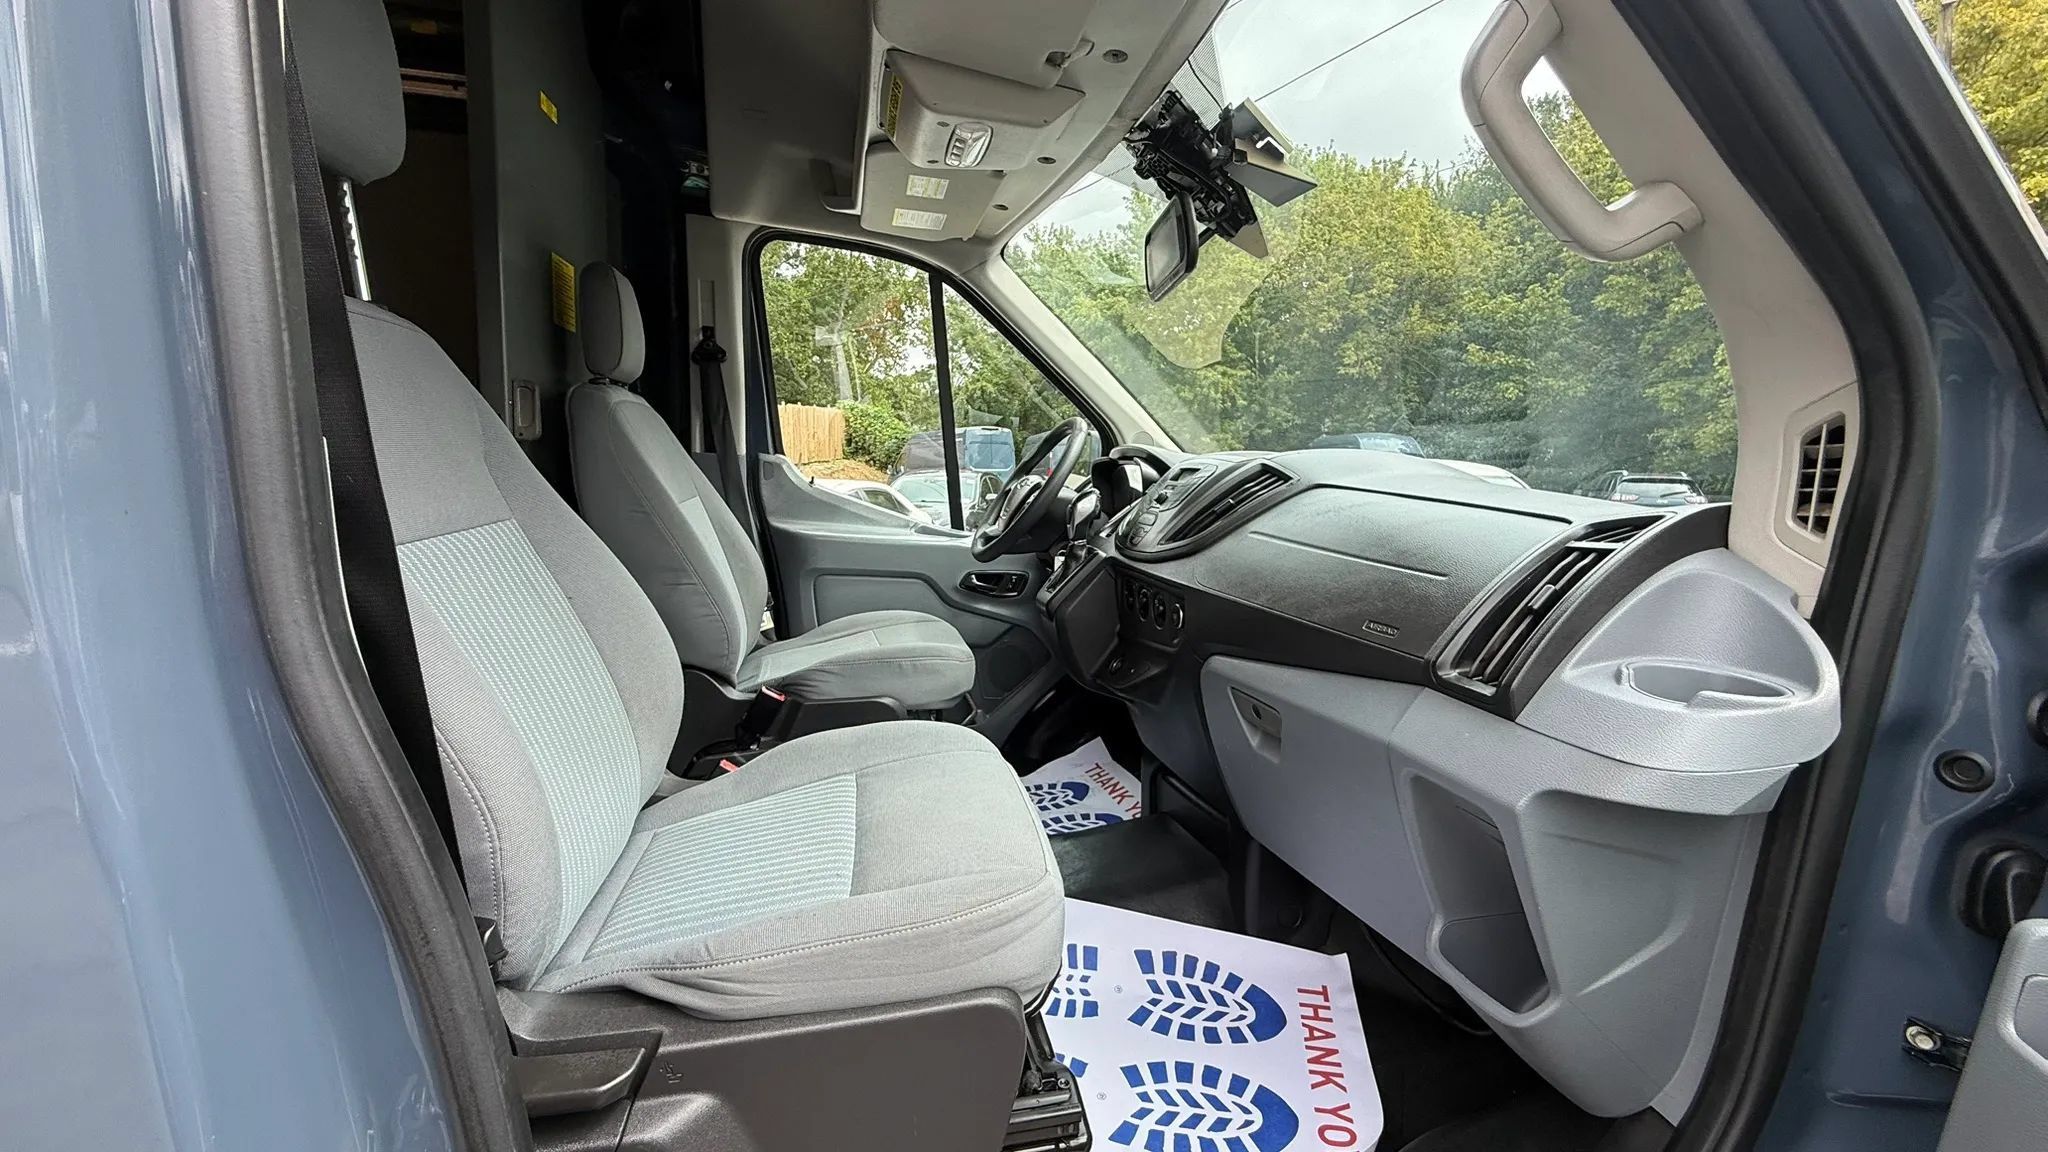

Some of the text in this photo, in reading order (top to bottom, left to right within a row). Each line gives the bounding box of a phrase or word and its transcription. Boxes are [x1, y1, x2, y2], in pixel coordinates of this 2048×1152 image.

[1085, 763, 1134, 805] THANK
[1297, 985, 1359, 1152] THANK YO
